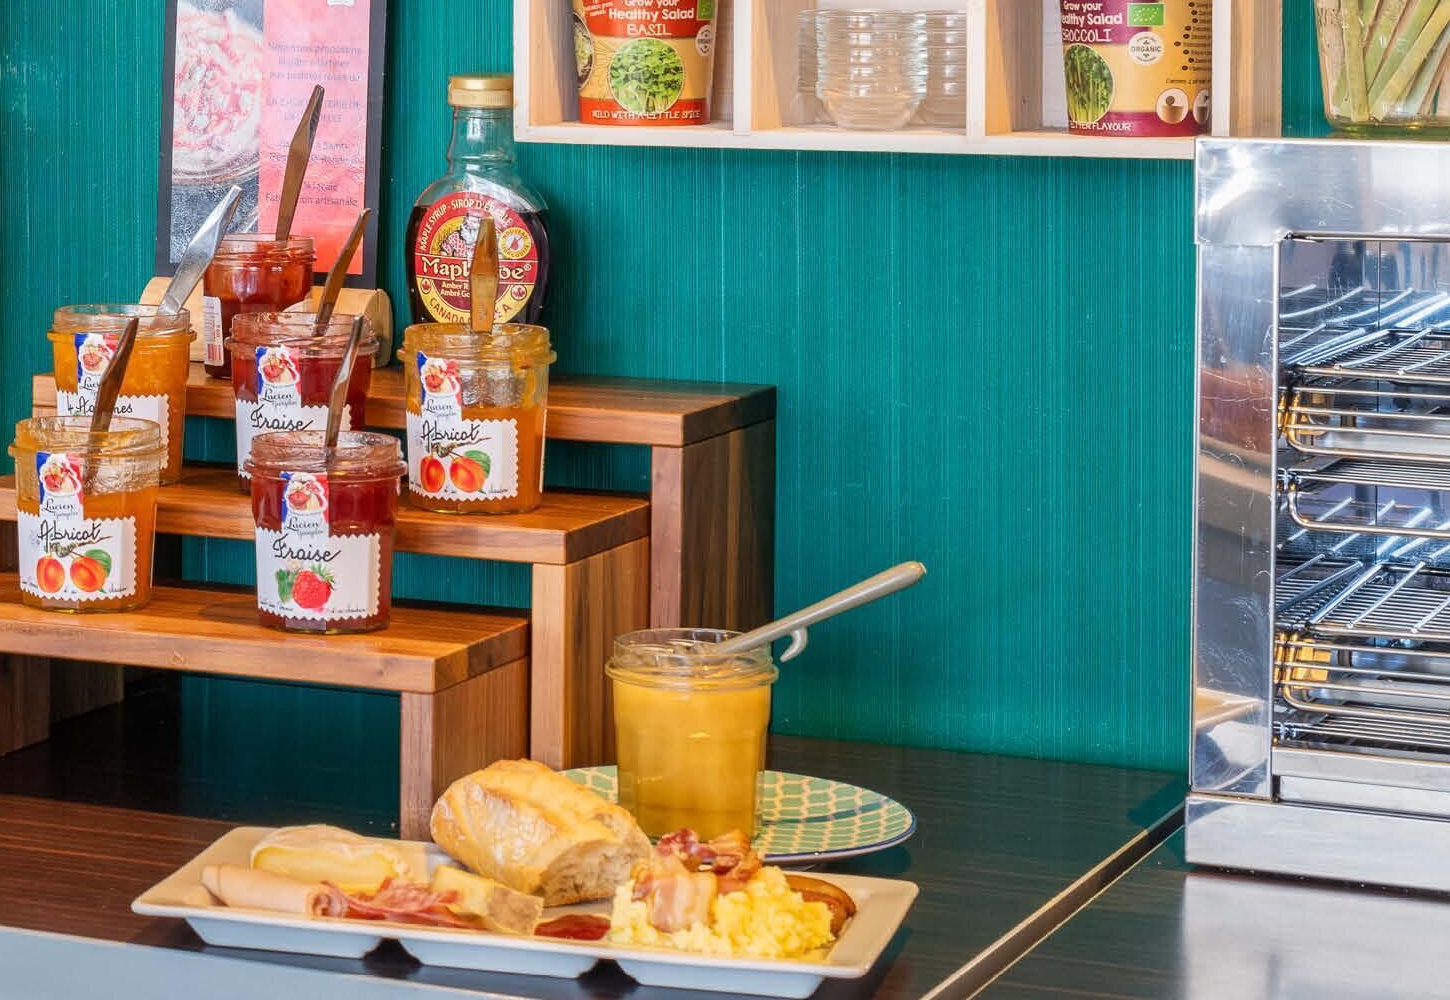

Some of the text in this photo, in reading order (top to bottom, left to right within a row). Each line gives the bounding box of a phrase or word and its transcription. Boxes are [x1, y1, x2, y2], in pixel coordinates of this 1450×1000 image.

[1063, 0, 1103, 13] Grow your
[608, 7, 659, 23] Healthy
[661, 7, 695, 20] Salad
[1061, 12, 1123, 28] ealthy Salad
[627, 23, 672, 36] BASIL
[1130, 45, 1163, 54] ORGANIC
[612, 110, 635, 120] WITH
[646, 110, 680, 120] LITTLE
[420, 224, 431, 251] MAPLE
[430, 204, 448, 226] SYRUP
[451, 198, 474, 210] SIROP
[421, 256, 471, 281] Mapl
[440, 280, 463, 290] Amber
[260, 387, 294, 403] Lucien
[425, 398, 454, 414] Lucien
[250, 403, 314, 432] Fraise
[420, 420, 481, 453] Abricot
[43, 498, 75, 514] Lucien
[285, 516, 320, 532] Lucien
[37, 519, 102, 553] Abricot
[272, 532, 342, 562] Fraise
